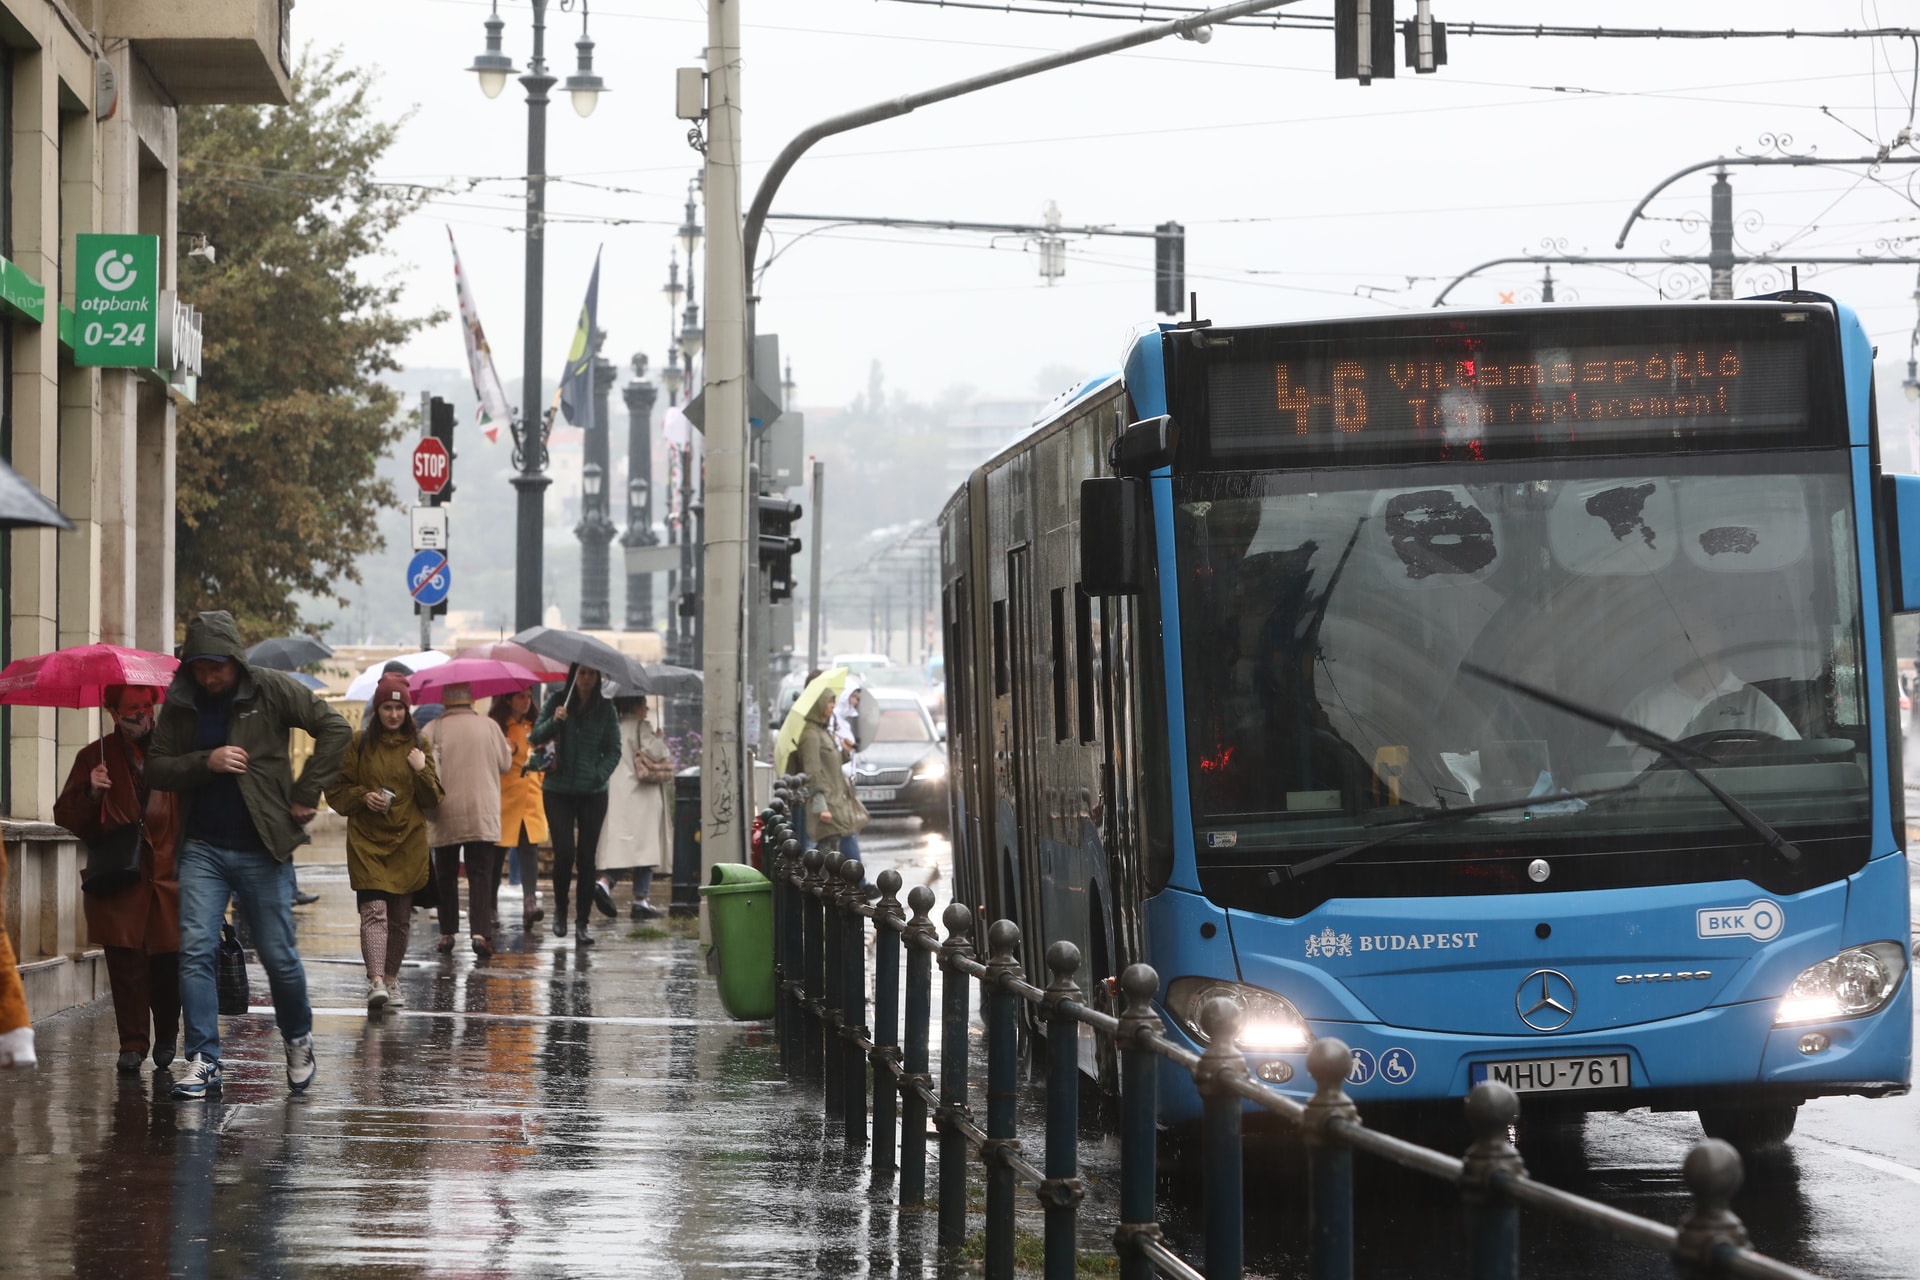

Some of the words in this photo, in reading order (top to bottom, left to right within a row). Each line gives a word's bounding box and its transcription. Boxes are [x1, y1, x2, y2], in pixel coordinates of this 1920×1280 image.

[81, 296, 149, 315] otpbank
[84, 322, 146, 346] 0-24
[1276, 361, 1368, 435] 4-6
[1510, 386, 1728, 424] replacement
[415, 453, 446, 478] STOP
[1709, 915, 1745, 930] BKK
[1359, 932, 1479, 952] BUDAPEST
[1615, 970, 1712, 984] CITARO
[1493, 1059, 1620, 1090] MHU-761
